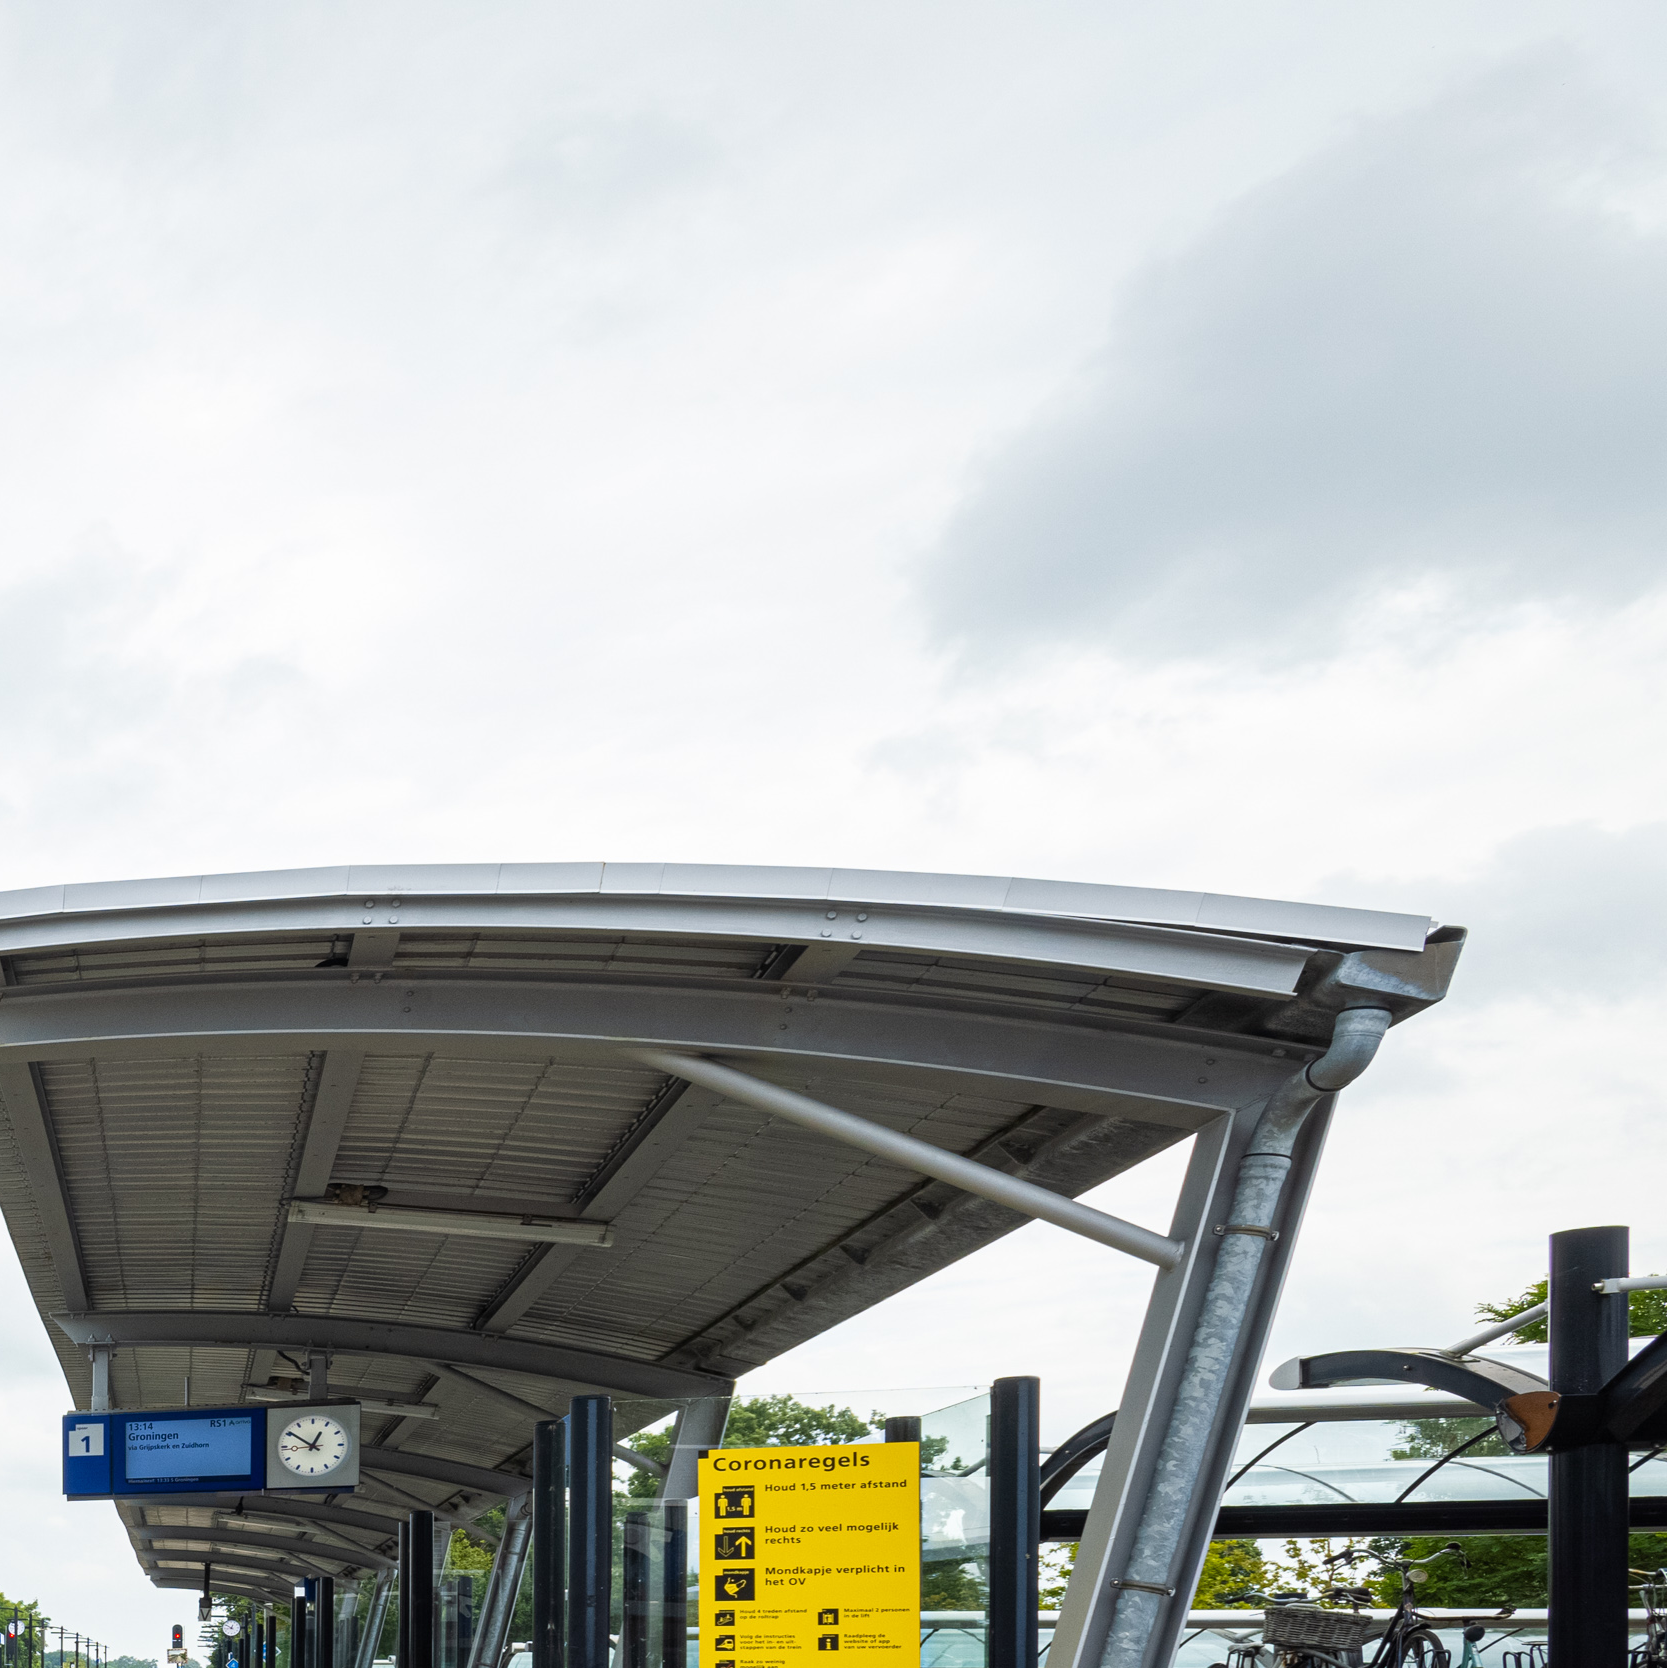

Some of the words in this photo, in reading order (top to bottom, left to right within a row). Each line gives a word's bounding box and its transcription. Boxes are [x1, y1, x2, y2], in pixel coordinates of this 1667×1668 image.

[128, 1423, 153, 1431] 13:14
[210, 1419, 227, 1428] RS1
[128, 1432, 179, 1442] Groningen
[80, 1435, 90, 1453] 1
[713, 1452, 870, 1472] Coronaregels
[765, 1484, 796, 1492] Houd
[801, 1483, 816, 1492] 1,5
[821, 1482, 855, 1490] meter
[860, 1480, 907, 1489] afstand
[765, 1525, 796, 1533] Houd
[818, 1524, 842, 1532] veel
[846, 1522, 899, 1534] mogelijk
[765, 1536, 801, 1544] rechts
[765, 1566, 832, 1576] Mondkapje
[836, 1565, 889, 1575] verplicht
[894, 1565, 906, 1573] in
[765, 1578, 785, 1586] het
